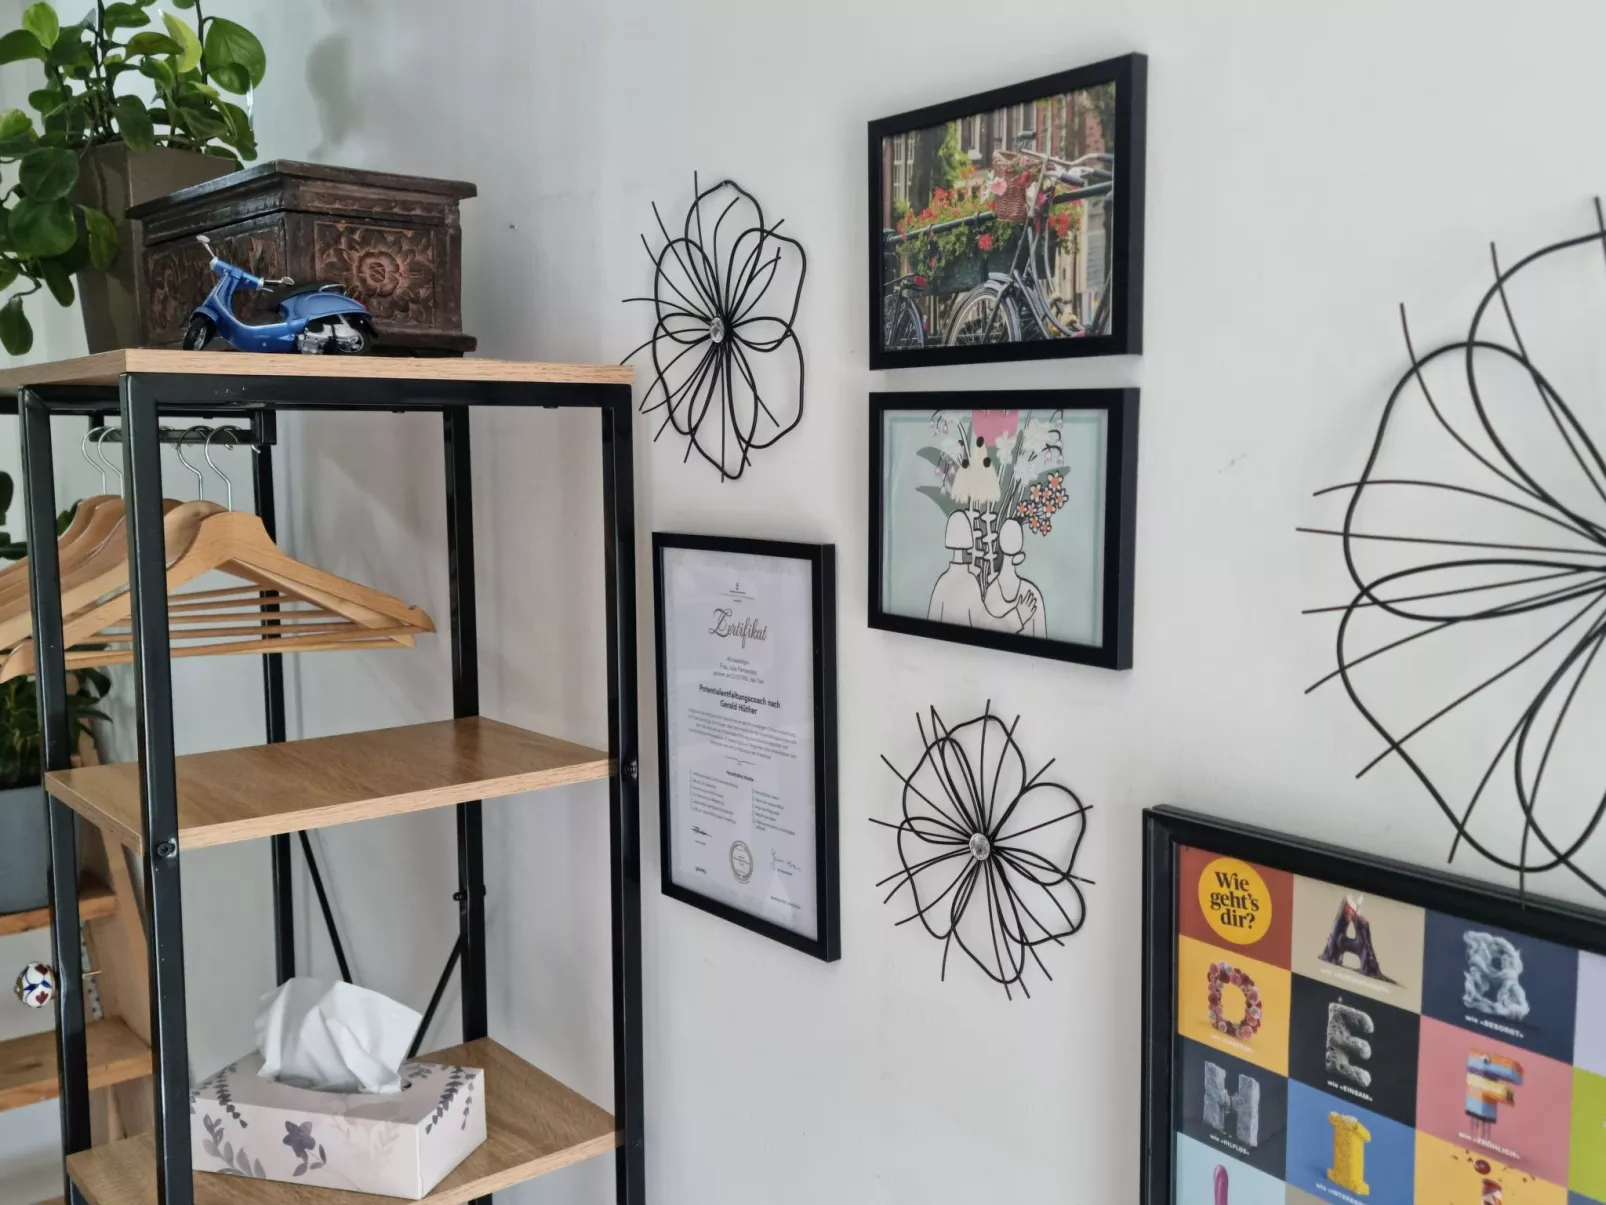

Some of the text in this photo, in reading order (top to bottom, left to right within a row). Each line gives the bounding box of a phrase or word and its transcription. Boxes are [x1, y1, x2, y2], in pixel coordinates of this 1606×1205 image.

[708, 608, 768, 648] Zertifikat
[699, 684, 780, 708] Potentialentfaltungscoach nach
[720, 700, 758, 714] Gerald Hüther
[1214, 871, 1250, 892] Wie
[1210, 890, 1260, 912] geht’s
[1220, 908, 1256, 930] dir?
[1464, 1014, 1478, 1024] wie
[1327, 1080, 1338, 1088] wie
